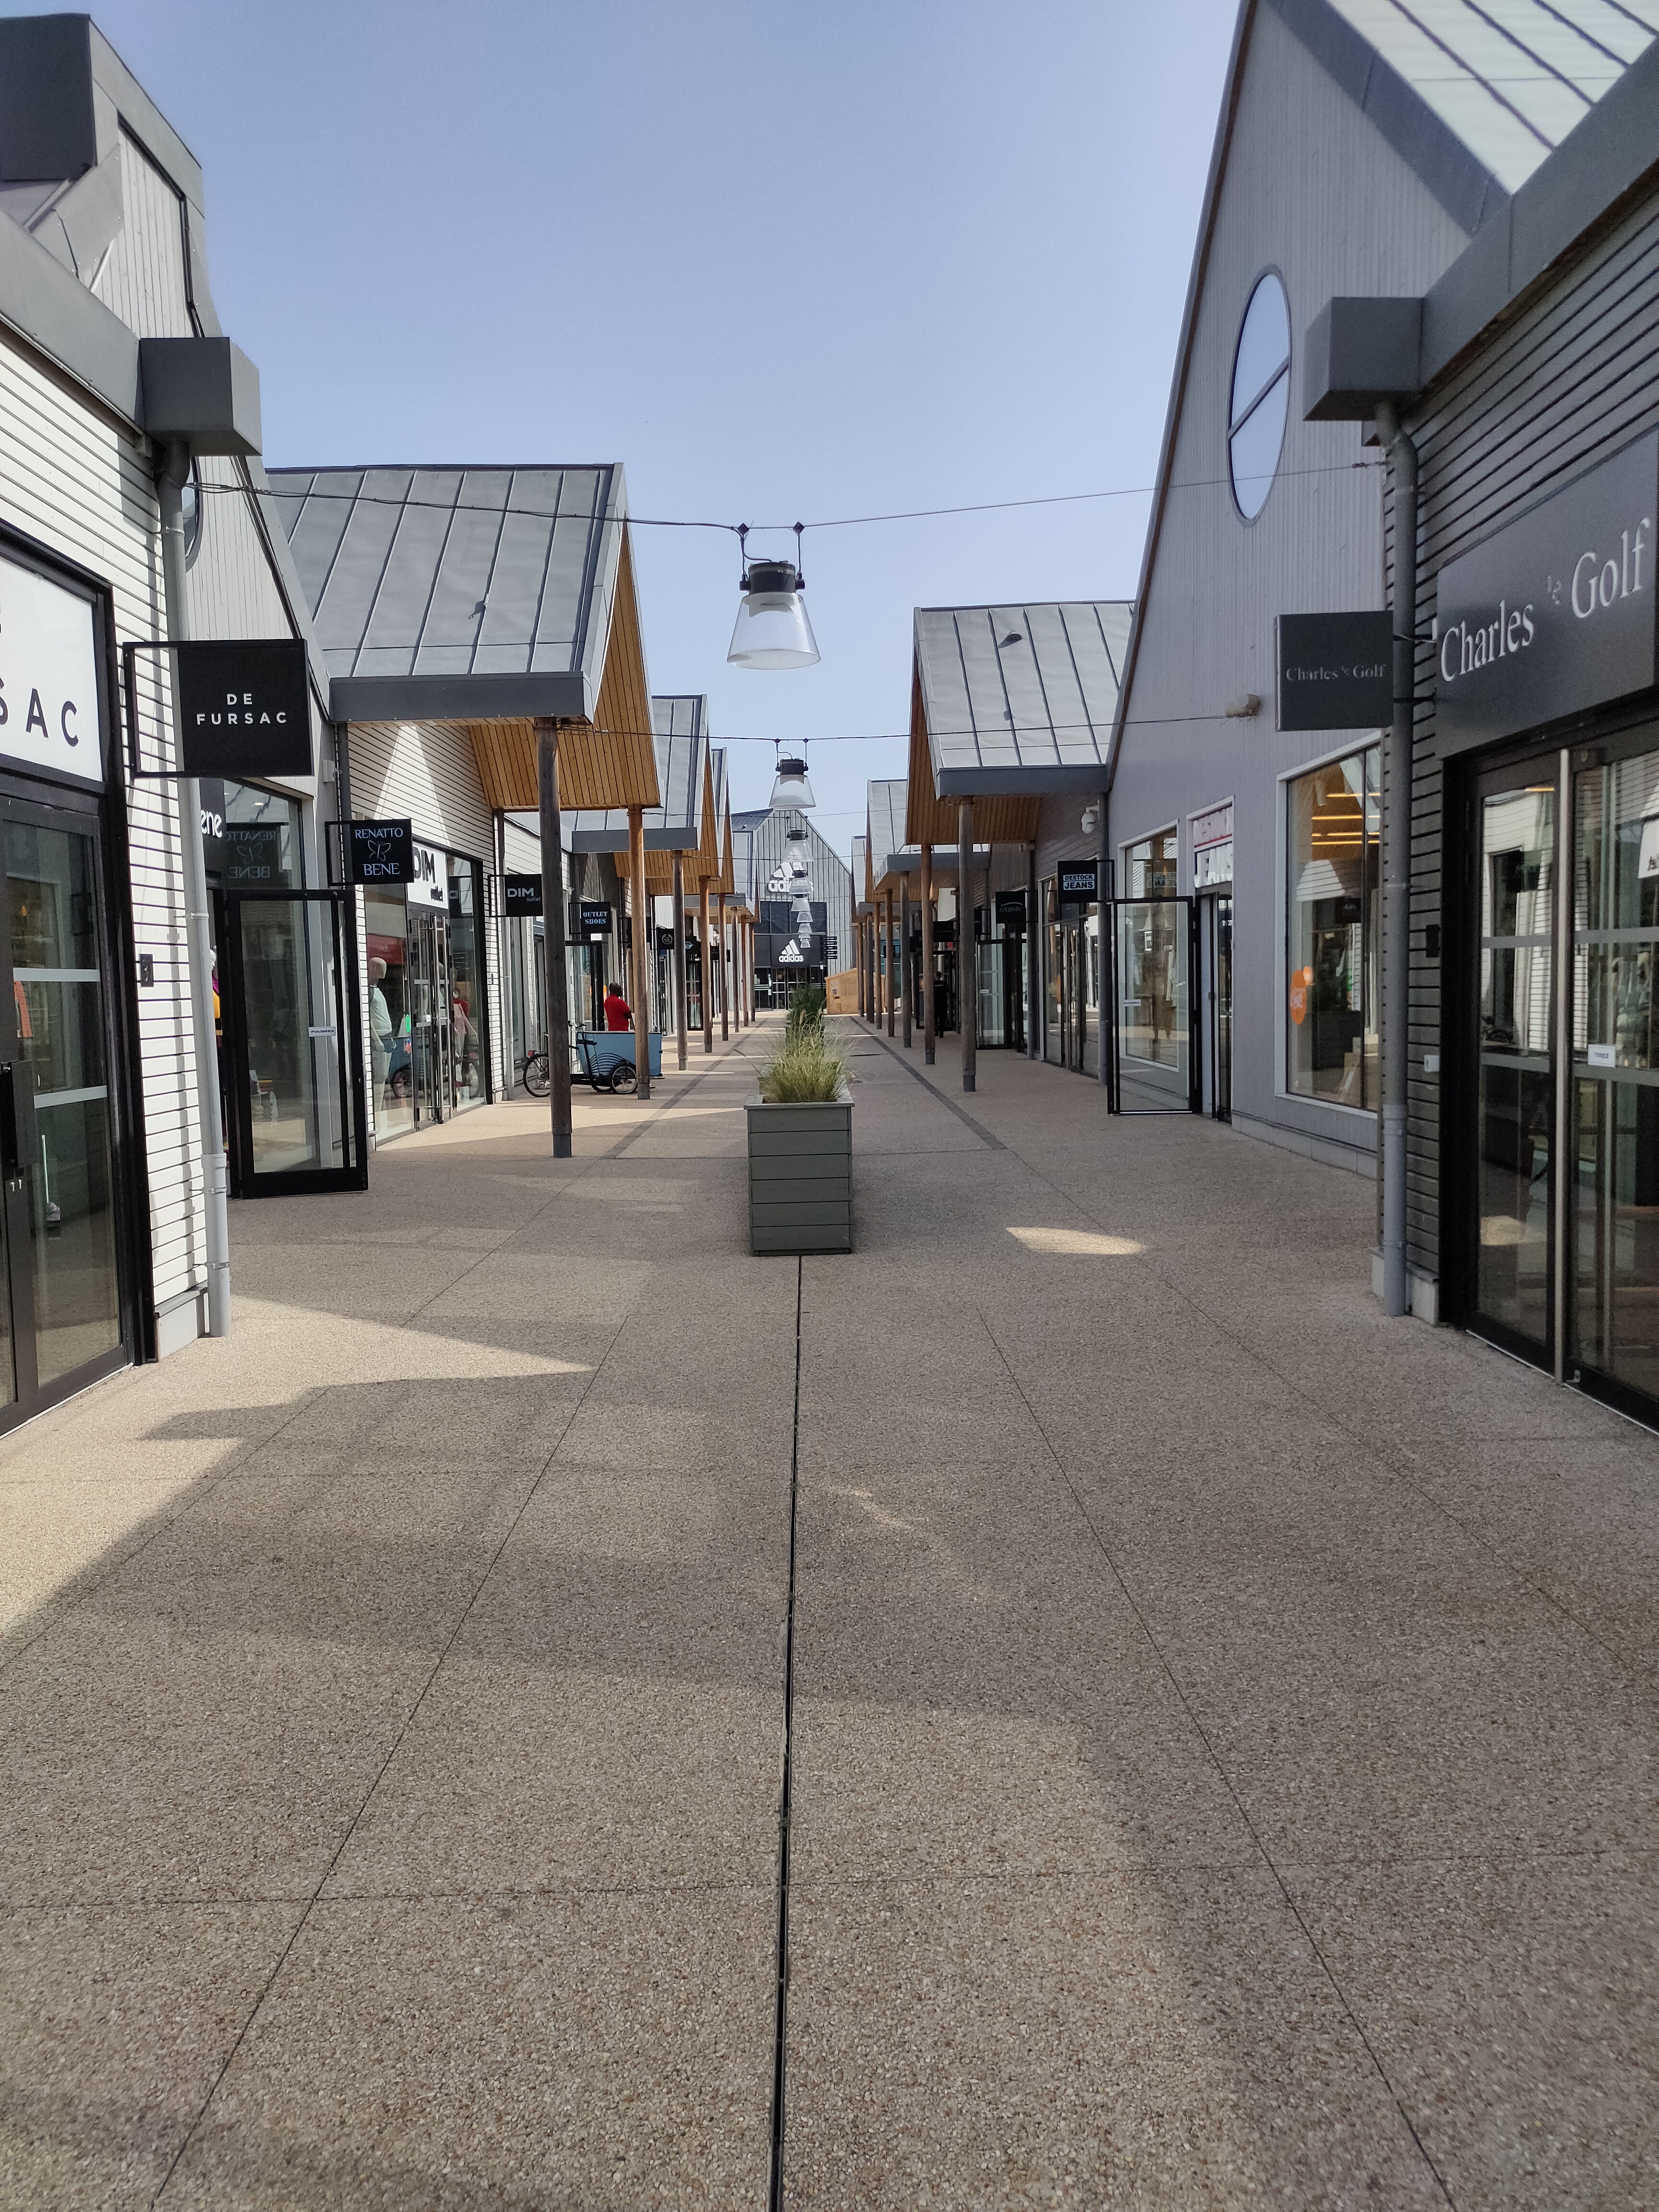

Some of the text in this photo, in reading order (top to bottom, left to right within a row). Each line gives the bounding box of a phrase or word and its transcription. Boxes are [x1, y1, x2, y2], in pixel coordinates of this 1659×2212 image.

[1441, 599, 1534, 682] Charles
[1571, 517, 1650, 619] Golf
[1286, 666, 1339, 681] Charles
[1352, 664, 1386, 678] Golf
[227, 693, 253, 705] DE
[196, 712, 287, 725] FURSAC
[354, 828, 403, 839] RENATTO
[361, 863, 400, 876] BENE
[412, 846, 436, 884] DIM
[507, 888, 534, 897] DIM
[779, 954, 804, 962] adidas
